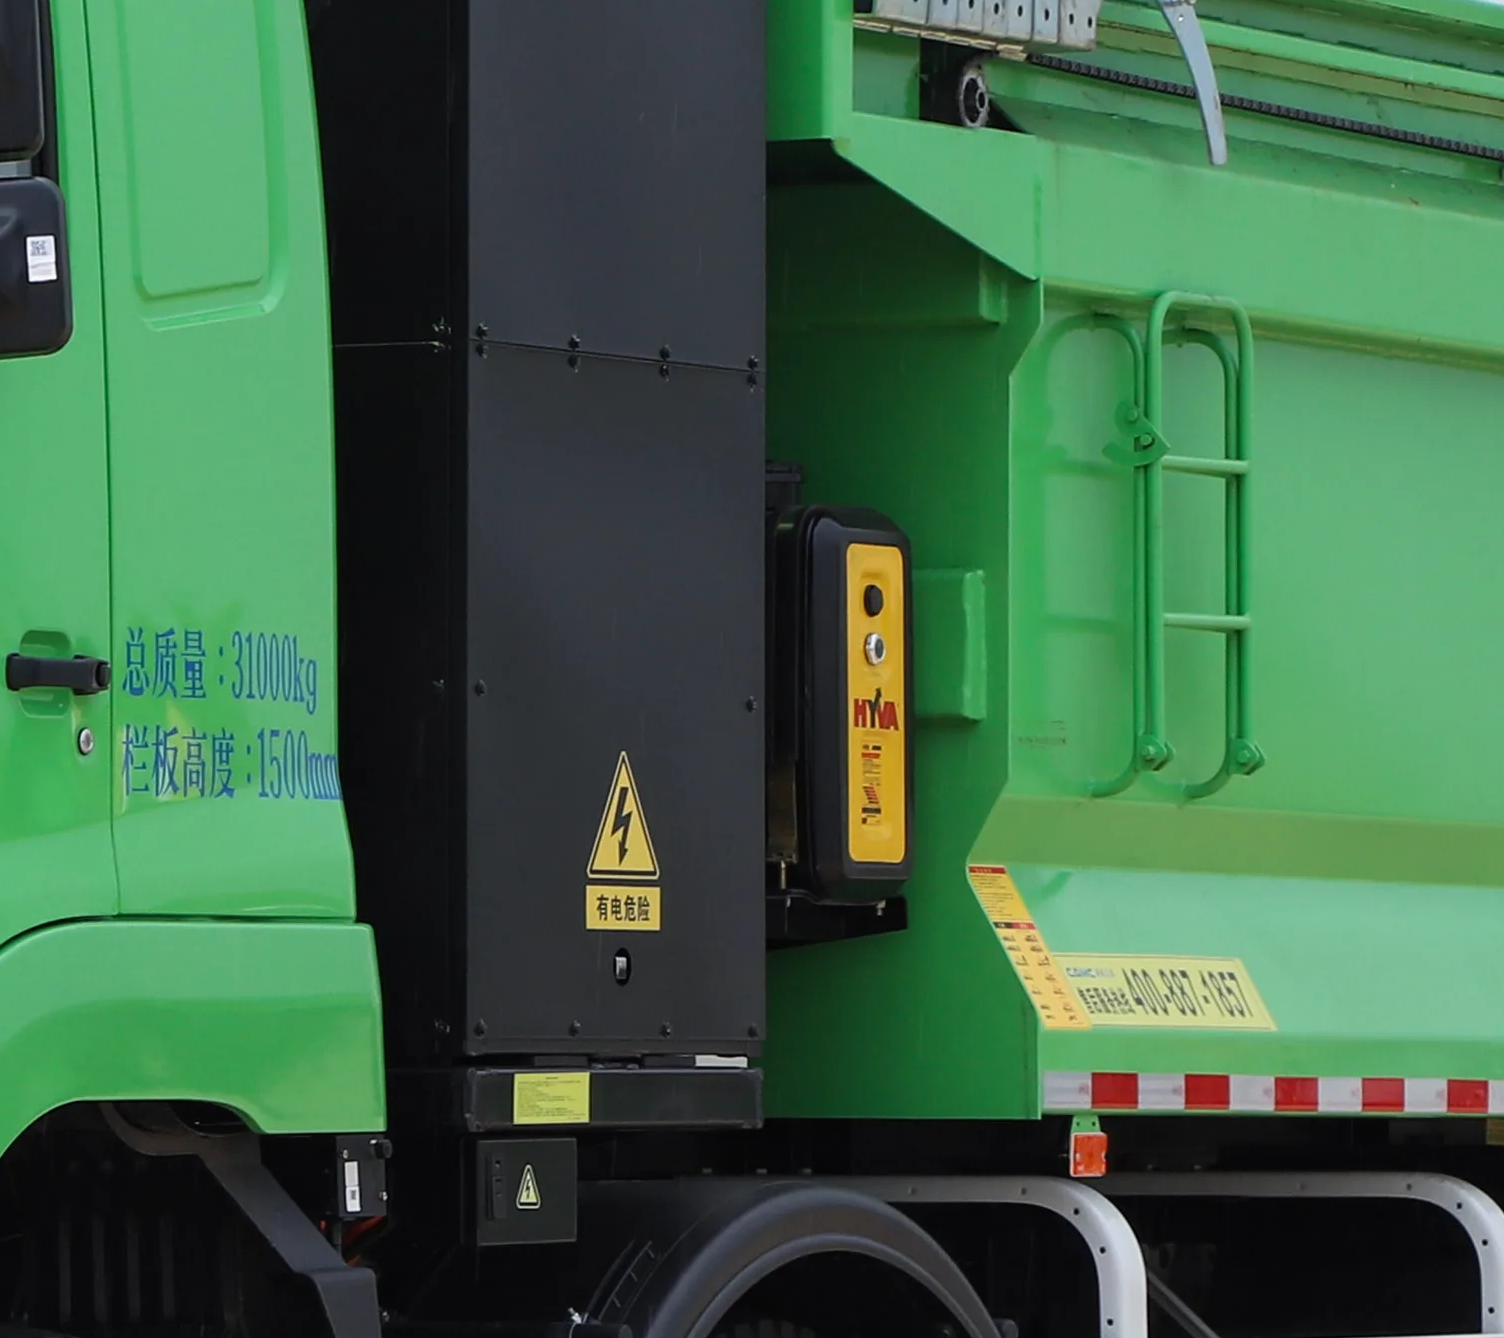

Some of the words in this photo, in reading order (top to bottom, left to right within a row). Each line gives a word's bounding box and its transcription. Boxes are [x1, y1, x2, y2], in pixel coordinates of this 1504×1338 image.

[853, 687, 899, 731] HYVA
[596, 894, 650, 922] 有电危险
